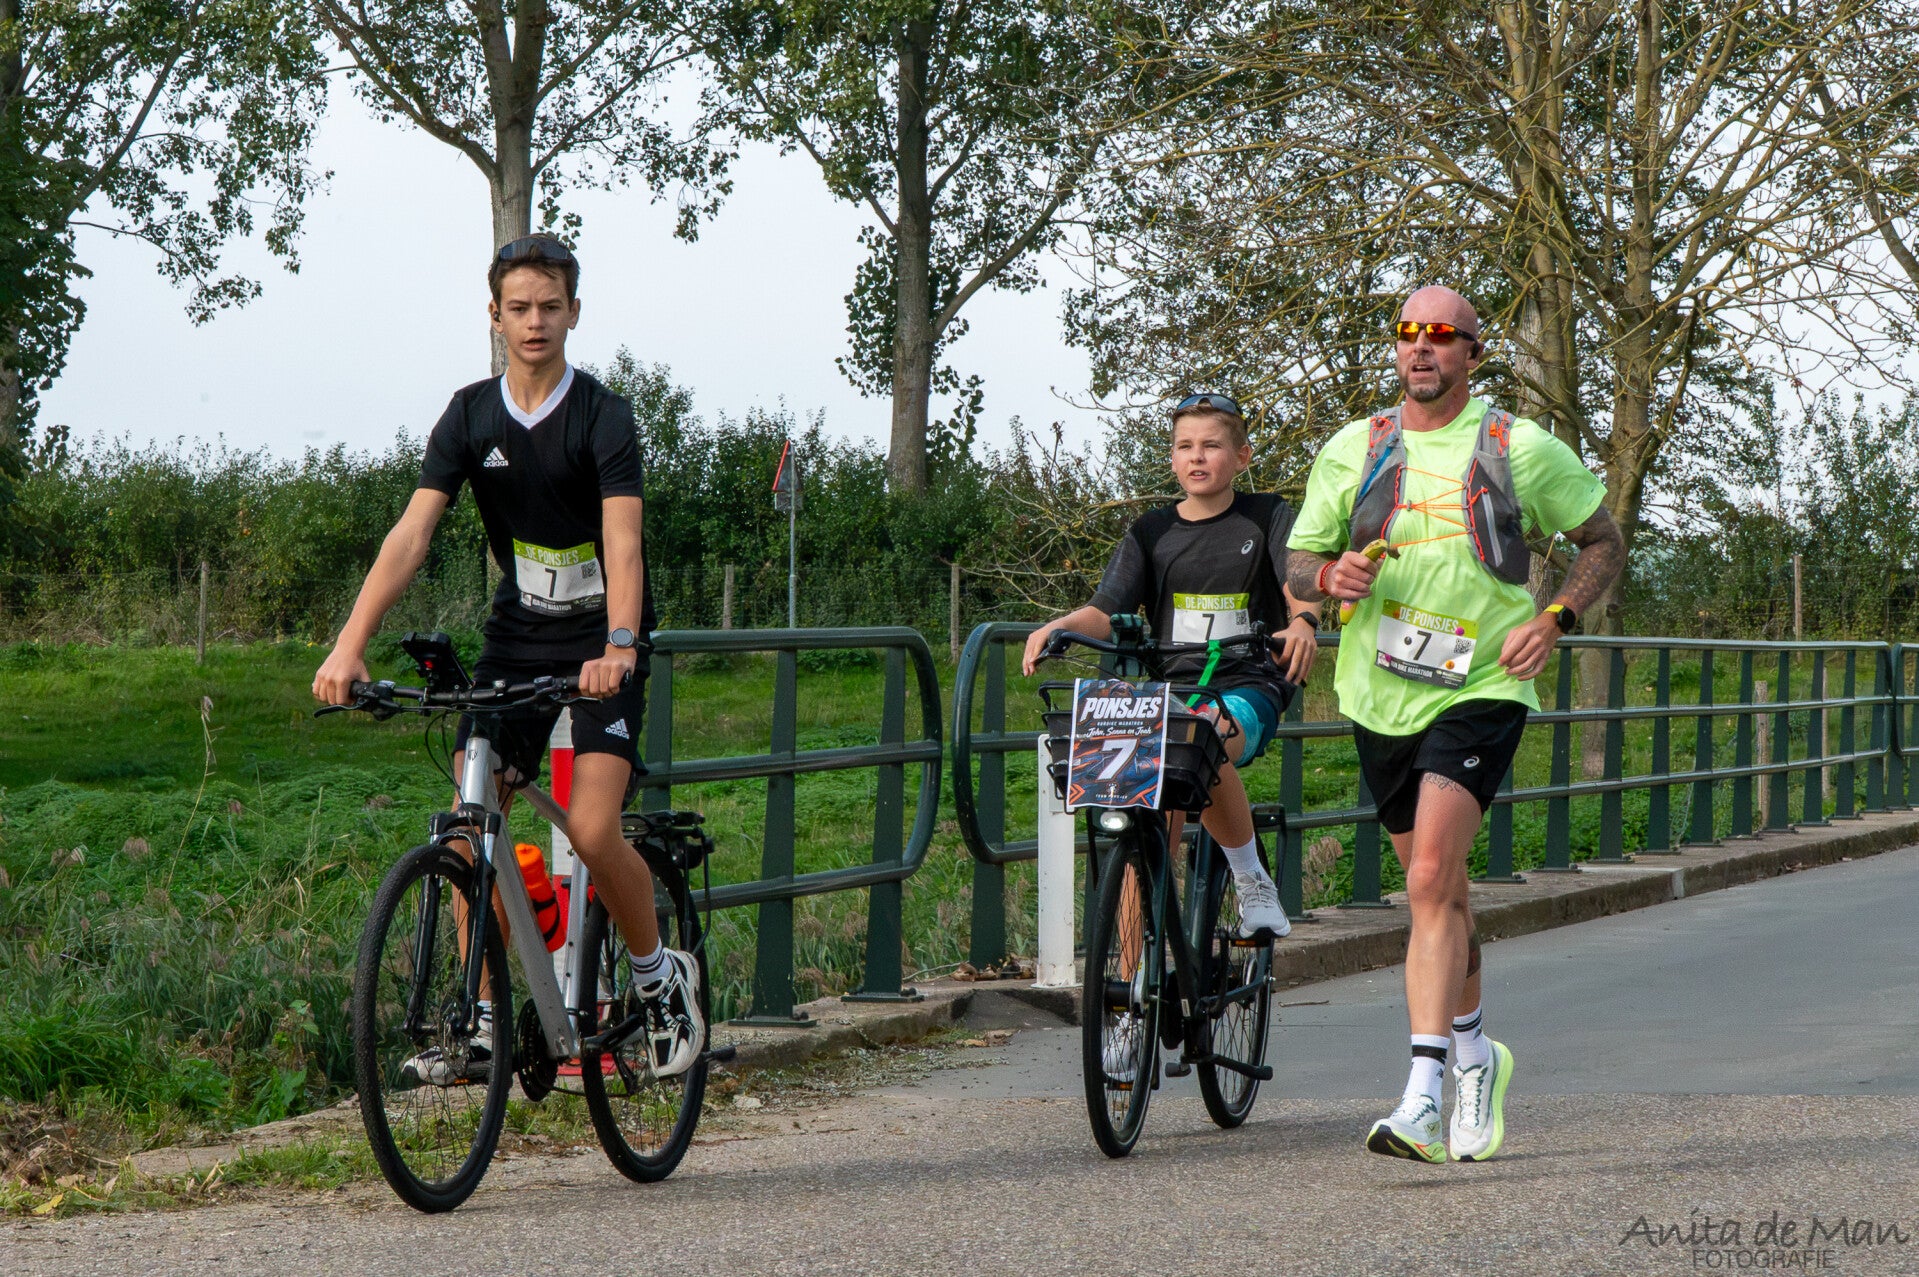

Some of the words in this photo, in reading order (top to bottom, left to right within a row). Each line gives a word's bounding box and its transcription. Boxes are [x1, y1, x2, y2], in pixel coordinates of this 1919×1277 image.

[526, 546, 537, 560] DE
[537, 549, 579, 566] PONSJES
[545, 568, 557, 598] 7
[1185, 596, 1196, 609] DE
[1197, 597, 1235, 610] PONSJES
[1202, 613, 1215, 641] 7
[1399, 606, 1413, 622] DE
[1413, 611, 1459, 632] PONSJES
[1413, 630, 1432, 661] 7
[1407, 666, 1433, 678] MARATHON
[1080, 697, 1162, 722] PONSJES
[605, 727, 629, 739] adidas
[1097, 739, 1138, 780] 7
